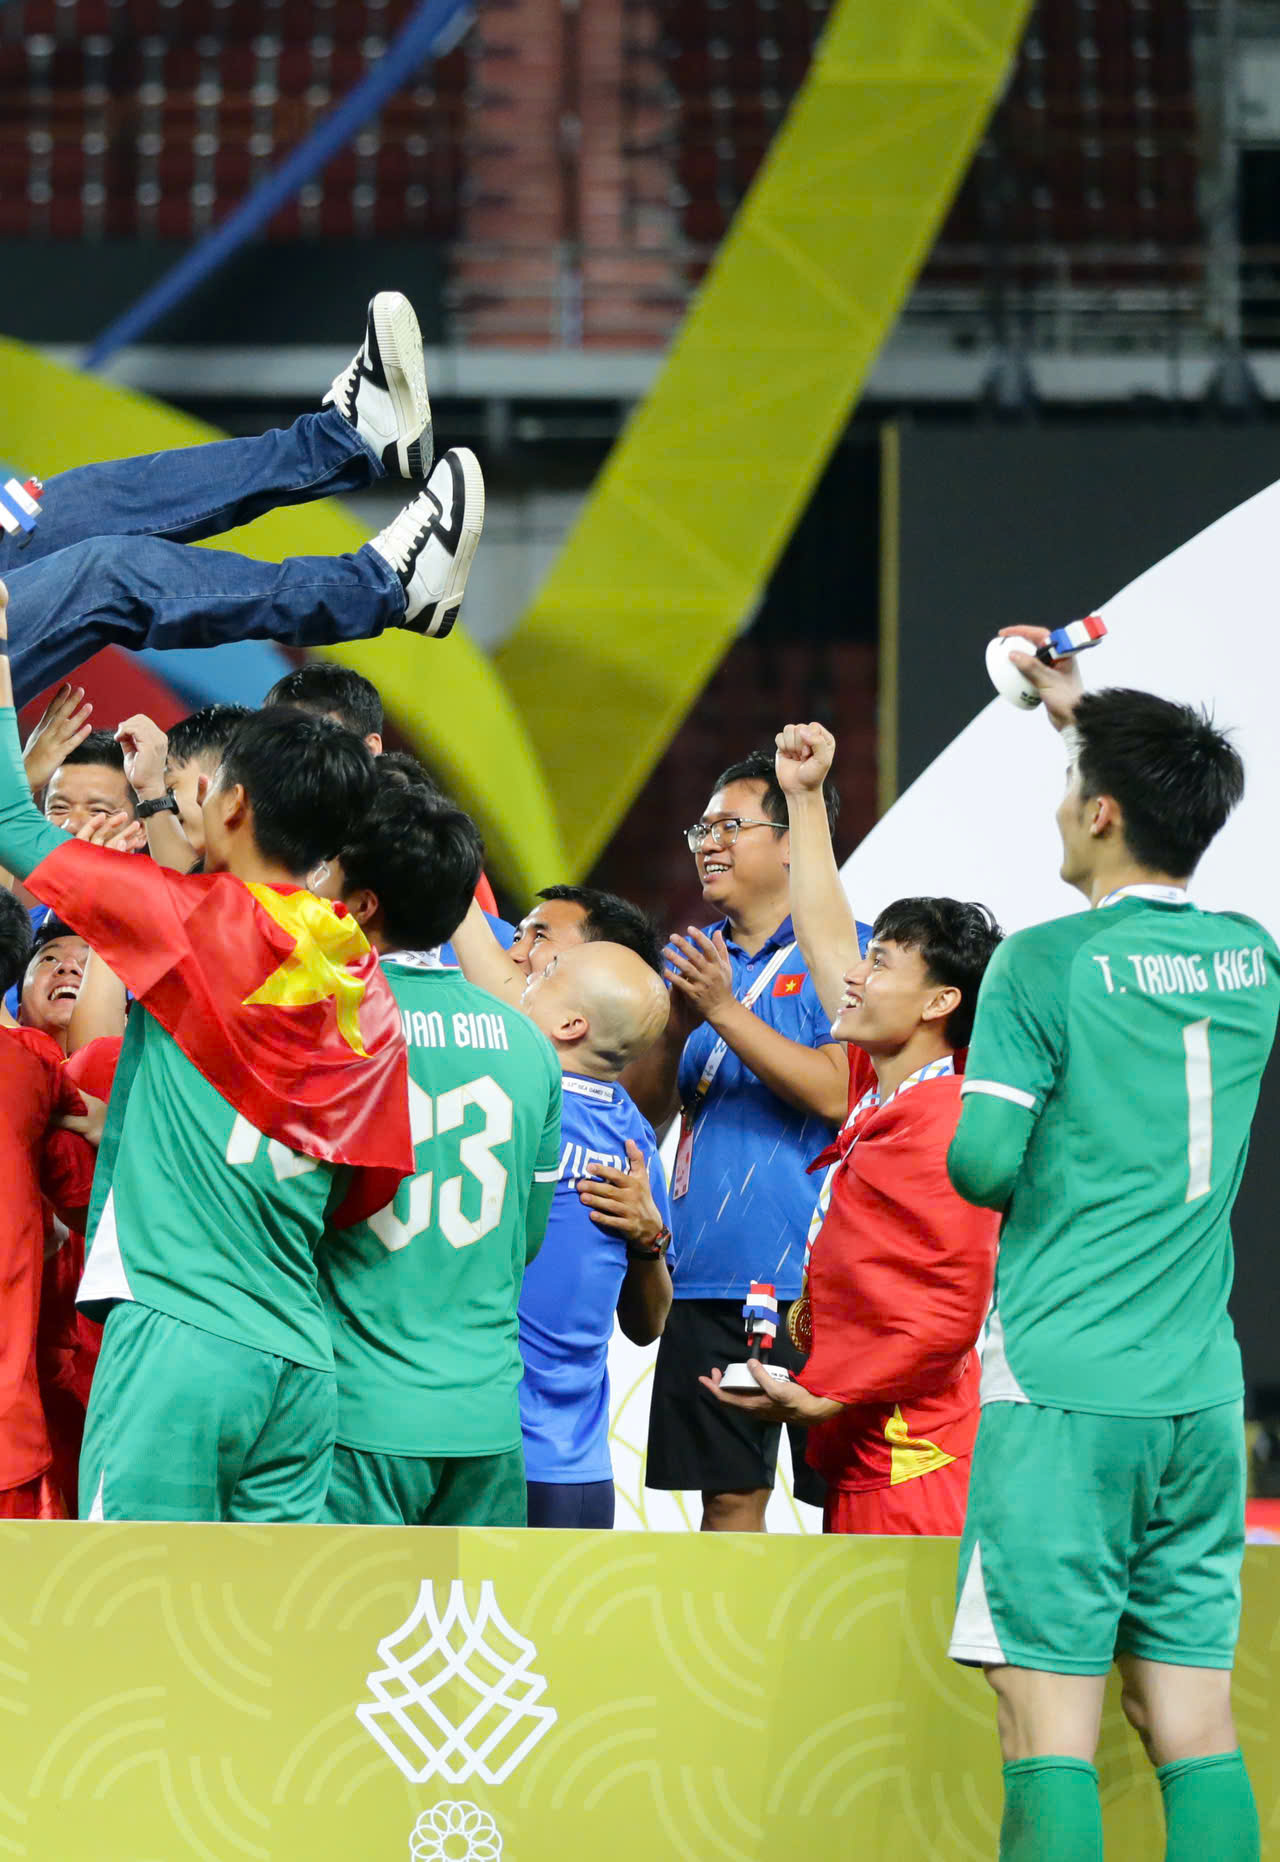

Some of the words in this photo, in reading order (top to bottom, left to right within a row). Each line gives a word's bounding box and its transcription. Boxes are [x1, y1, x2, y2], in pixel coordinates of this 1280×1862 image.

[1092, 955, 1127, 993] T.
[1128, 953, 1209, 995] TRUNG
[1213, 945, 1267, 992] KIEN
[452, 1012, 509, 1050] BINH
[1182, 1016, 1213, 1204] 1
